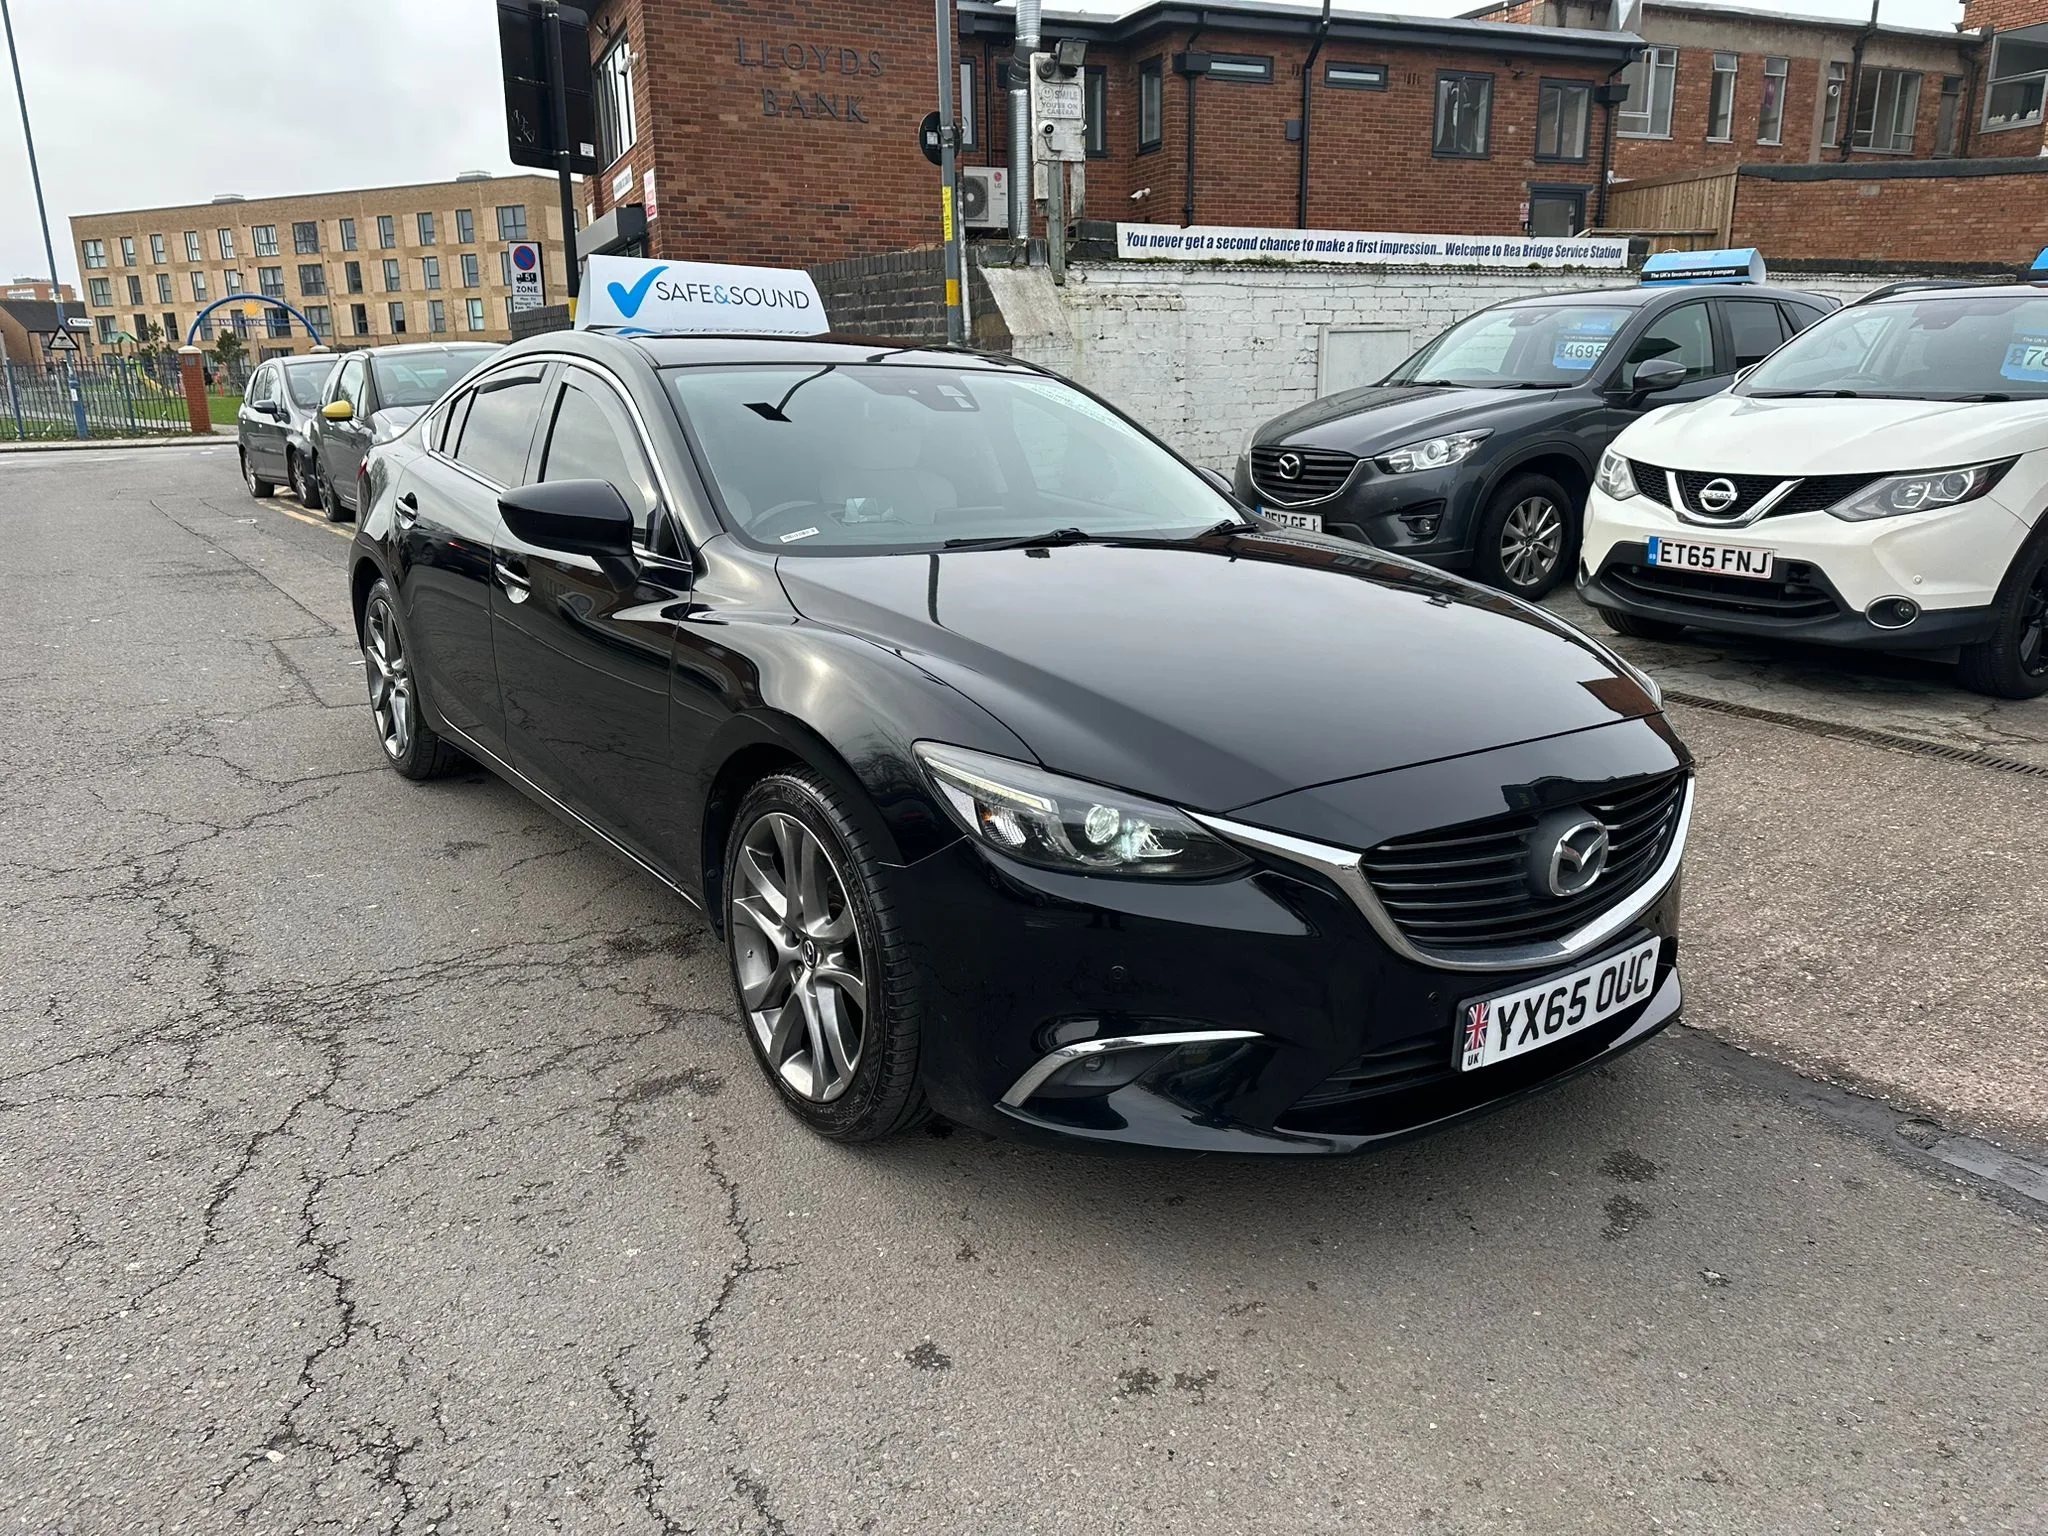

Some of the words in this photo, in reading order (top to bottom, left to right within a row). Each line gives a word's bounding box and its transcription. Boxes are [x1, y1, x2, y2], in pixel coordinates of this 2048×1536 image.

[737, 37, 883, 77] LLOYDS
[762, 88, 869, 123] BANK
[1054, 90, 1078, 100] SMILE
[1126, 232, 1147, 247] You
[1150, 235, 1184, 249] never
[1185, 236, 1205, 250] get
[1206, 237, 1214, 249] a
[1216, 236, 1257, 250] second
[1259, 237, 1300, 251] chance
[1302, 239, 1313, 252] to
[1315, 239, 1345, 252] make
[1347, 242, 1354, 253] a
[1356, 240, 1378, 254] first
[1446, 243, 1490, 257] Welcome
[1492, 245, 1501, 256] to
[1503, 244, 1520, 257] Rea
[1522, 244, 1553, 259] Bridge
[1555, 244, 1589, 258] Service
[1591, 245, 1622, 258] Station
[655, 281, 810, 309] SAFE&SOUND
[1702, 491, 1732, 499] NISSAN
[1660, 542, 1716, 568] ET65
[1721, 549, 1767, 573] FNJ
[1498, 976, 1591, 1051] YX65
[1596, 948, 1653, 1013] OUC
[1467, 1052, 1479, 1066] UK
